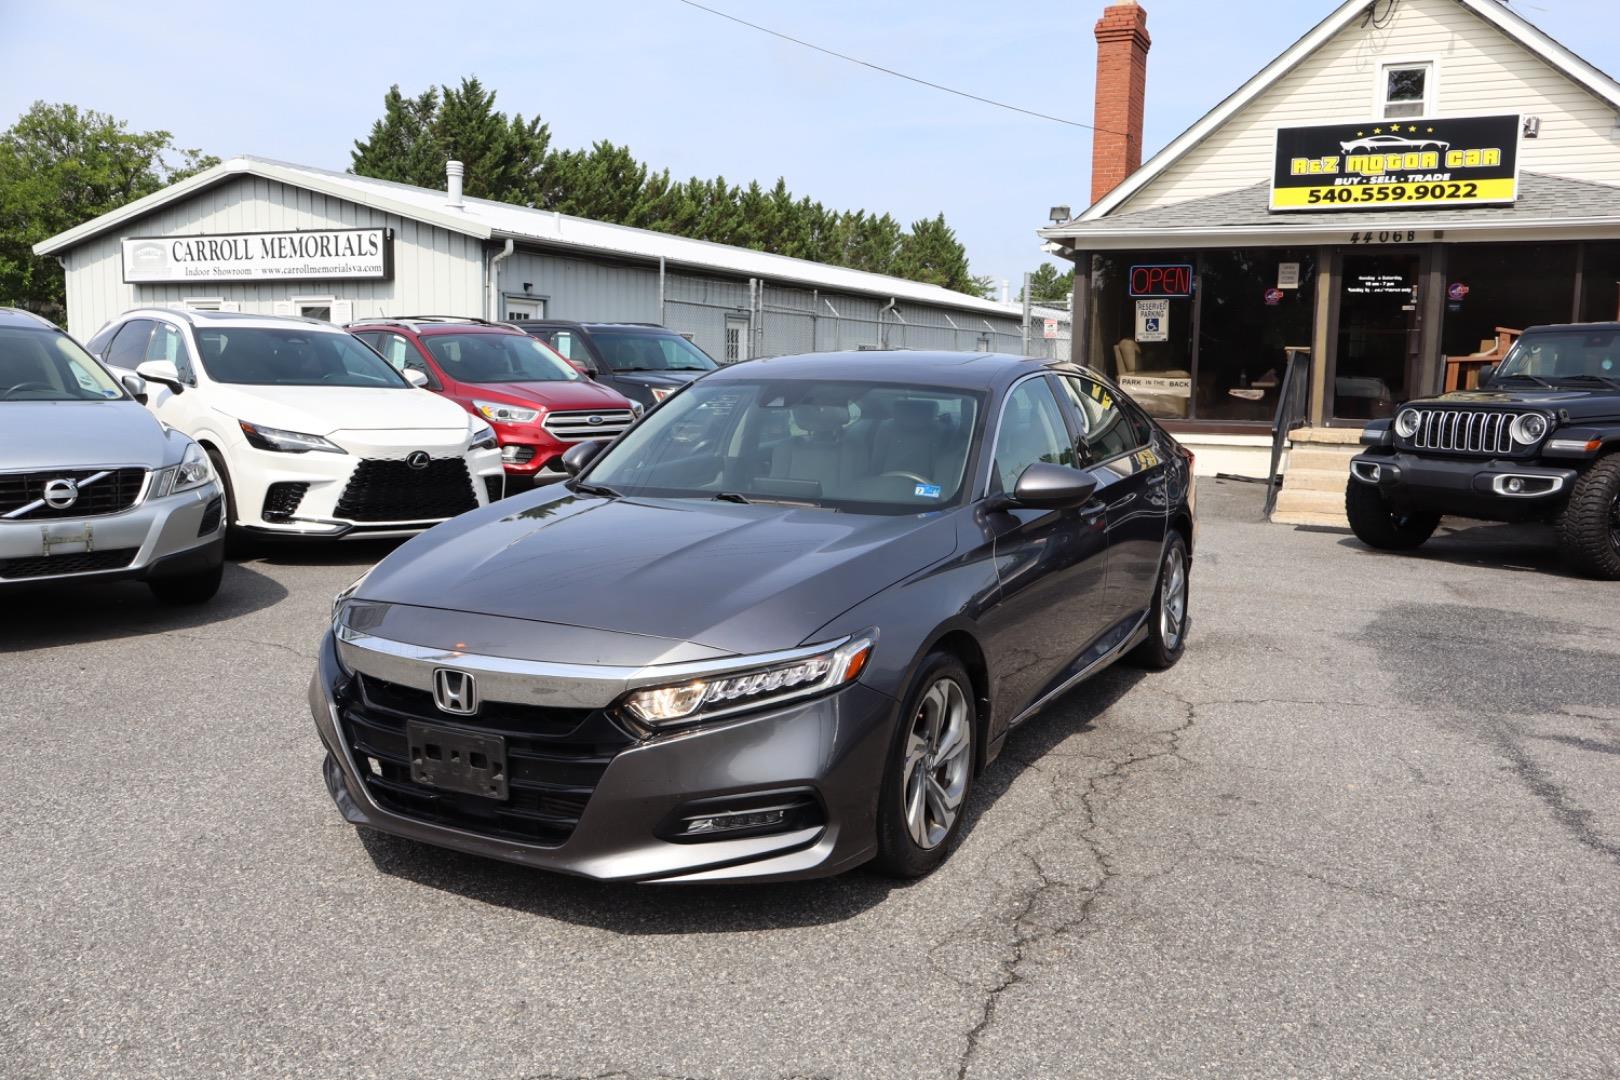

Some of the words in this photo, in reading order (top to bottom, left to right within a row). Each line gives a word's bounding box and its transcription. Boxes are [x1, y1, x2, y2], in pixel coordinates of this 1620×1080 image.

[1334, 176, 1361, 186] BUY
[1370, 175, 1398, 184] SELL
[1407, 173, 1451, 183] TRADE
[1307, 183, 1478, 204] 540.559.9022
[1350, 230, 1415, 244] 4406B
[172, 238, 254, 263] CARROLL
[261, 233, 379, 260] MEMORIALS
[185, 266, 210, 276] Indoor
[213, 265, 252, 276] Showroom
[261, 263, 382, 275] www.carrollmemorialsva.com
[1132, 267, 1189, 294] OPEN
[1122, 378, 1142, 386] PARK
